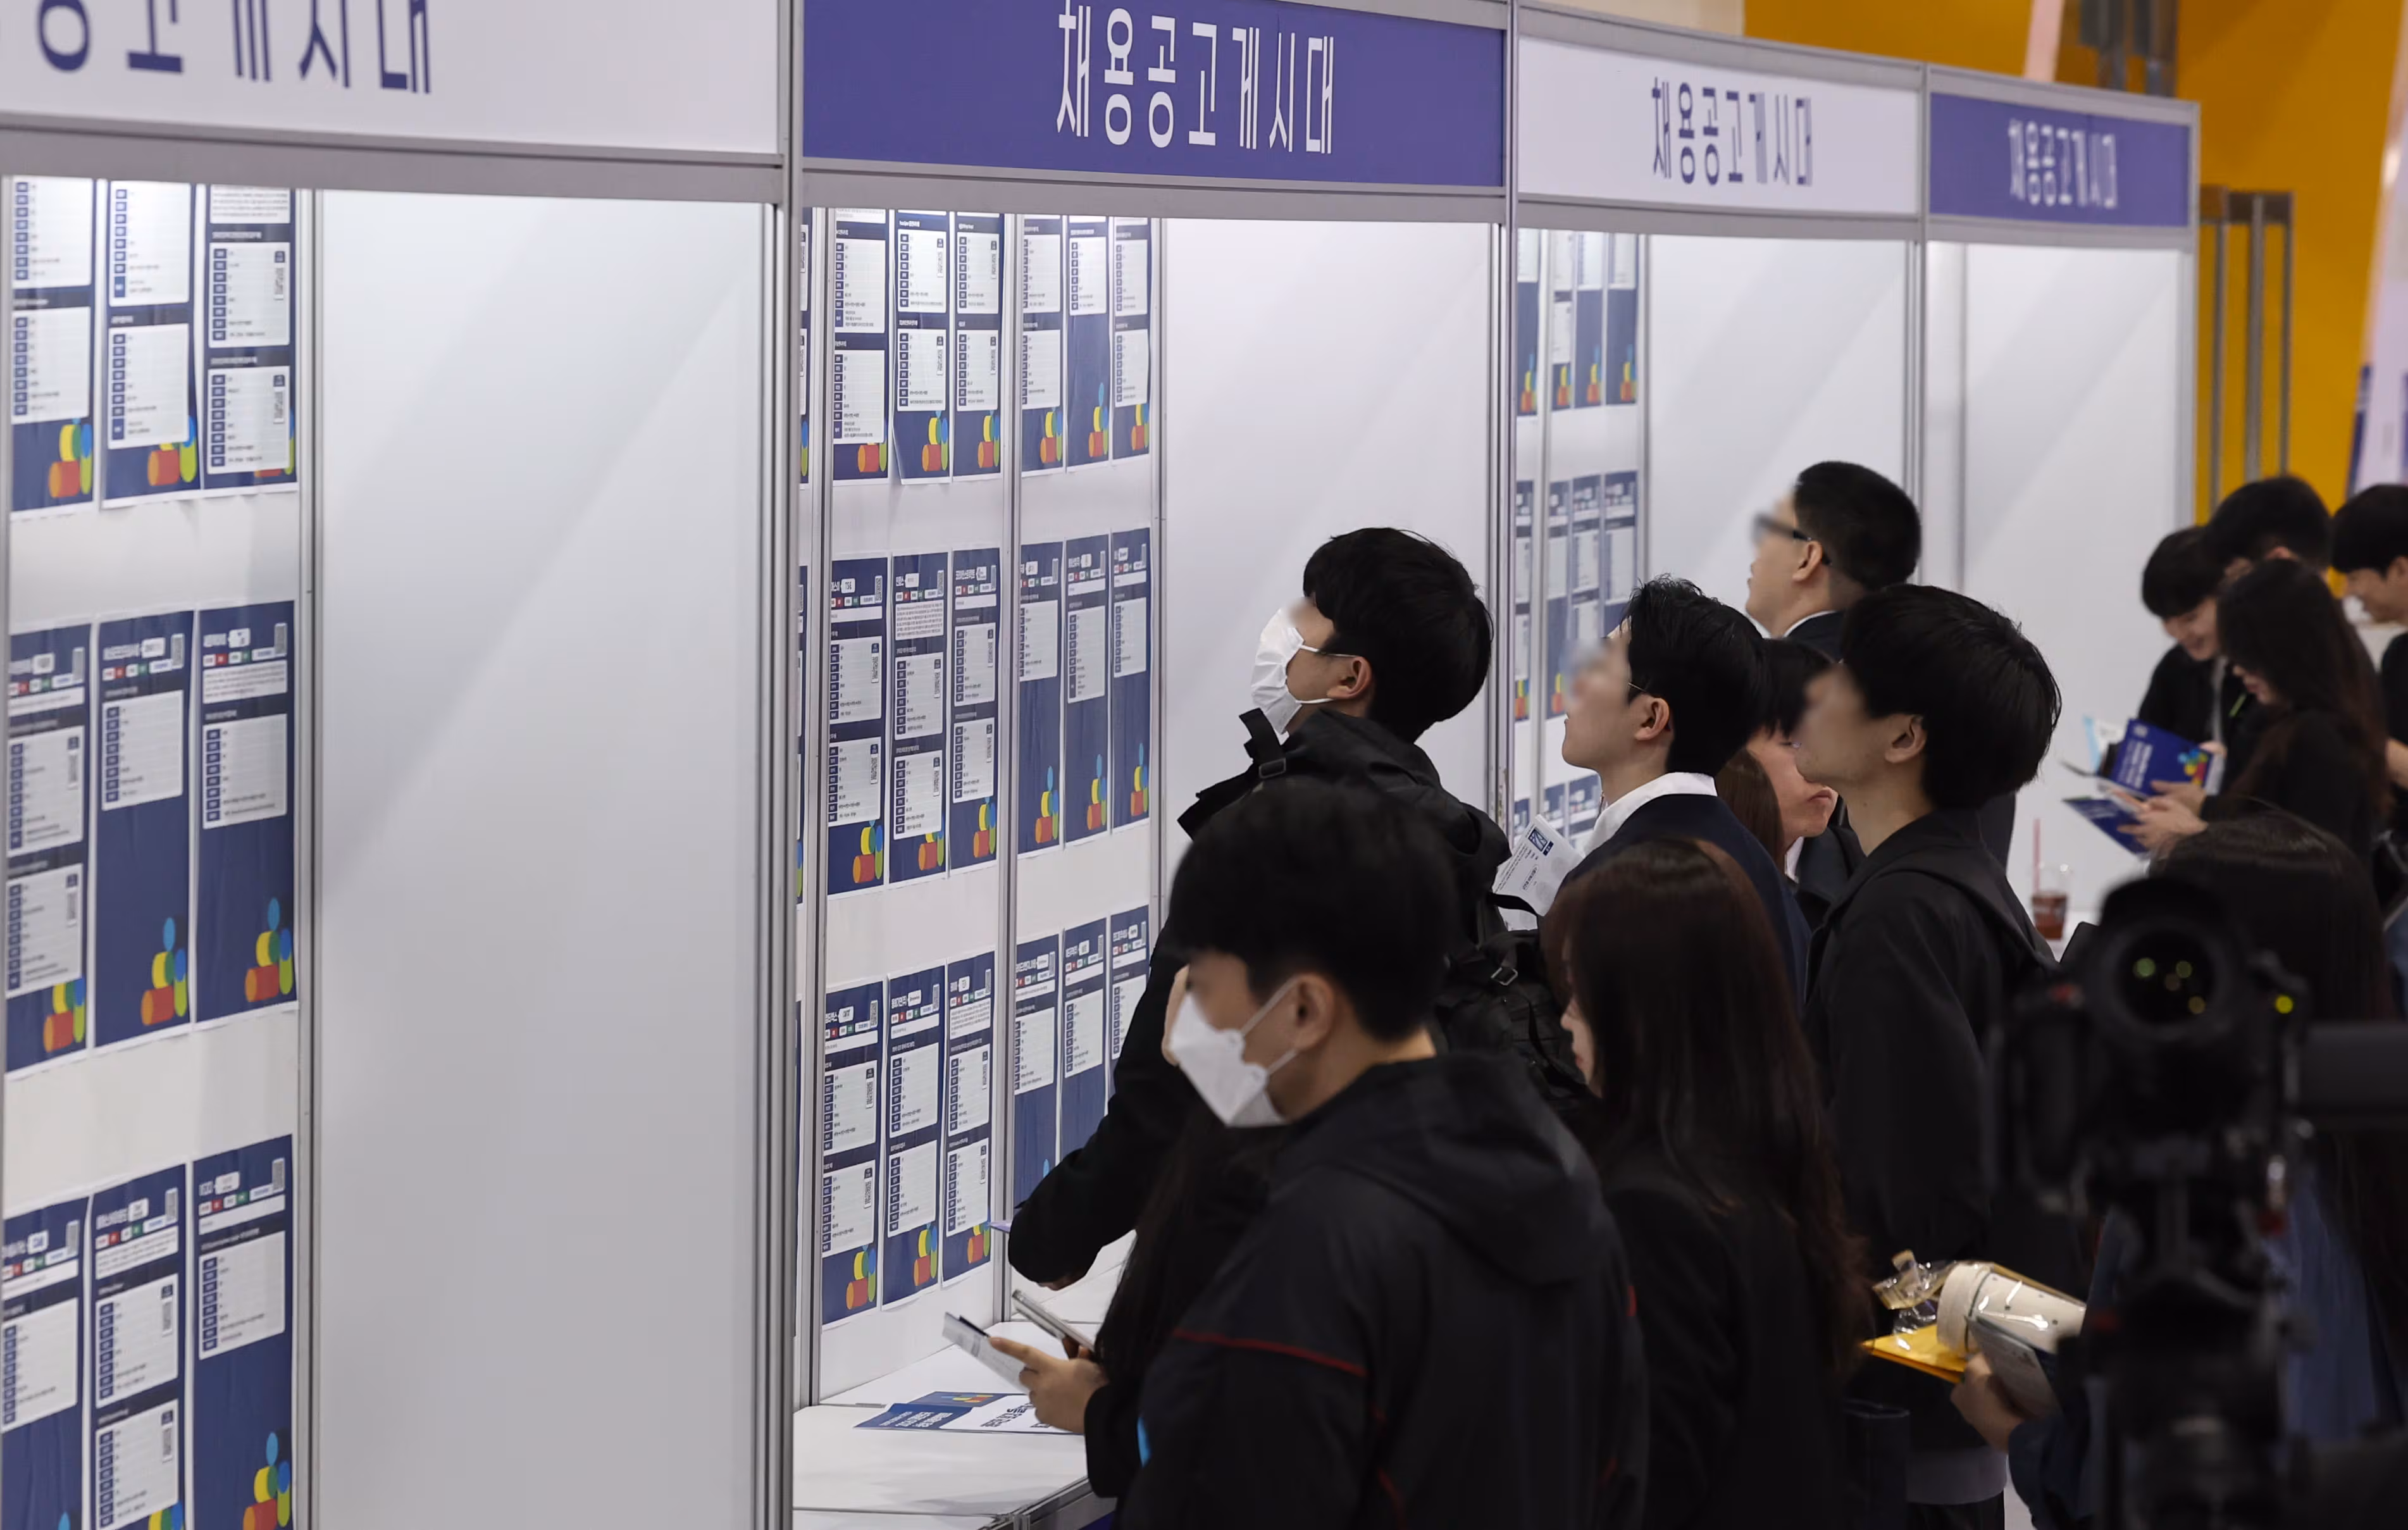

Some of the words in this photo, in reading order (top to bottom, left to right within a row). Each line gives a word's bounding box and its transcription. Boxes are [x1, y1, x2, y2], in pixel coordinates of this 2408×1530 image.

[1057, 0, 1334, 154] 채용공고게시대
[1651, 77, 1813, 187] 채용공고게시대
[2008, 118, 2118, 209] 채용공고게시대
